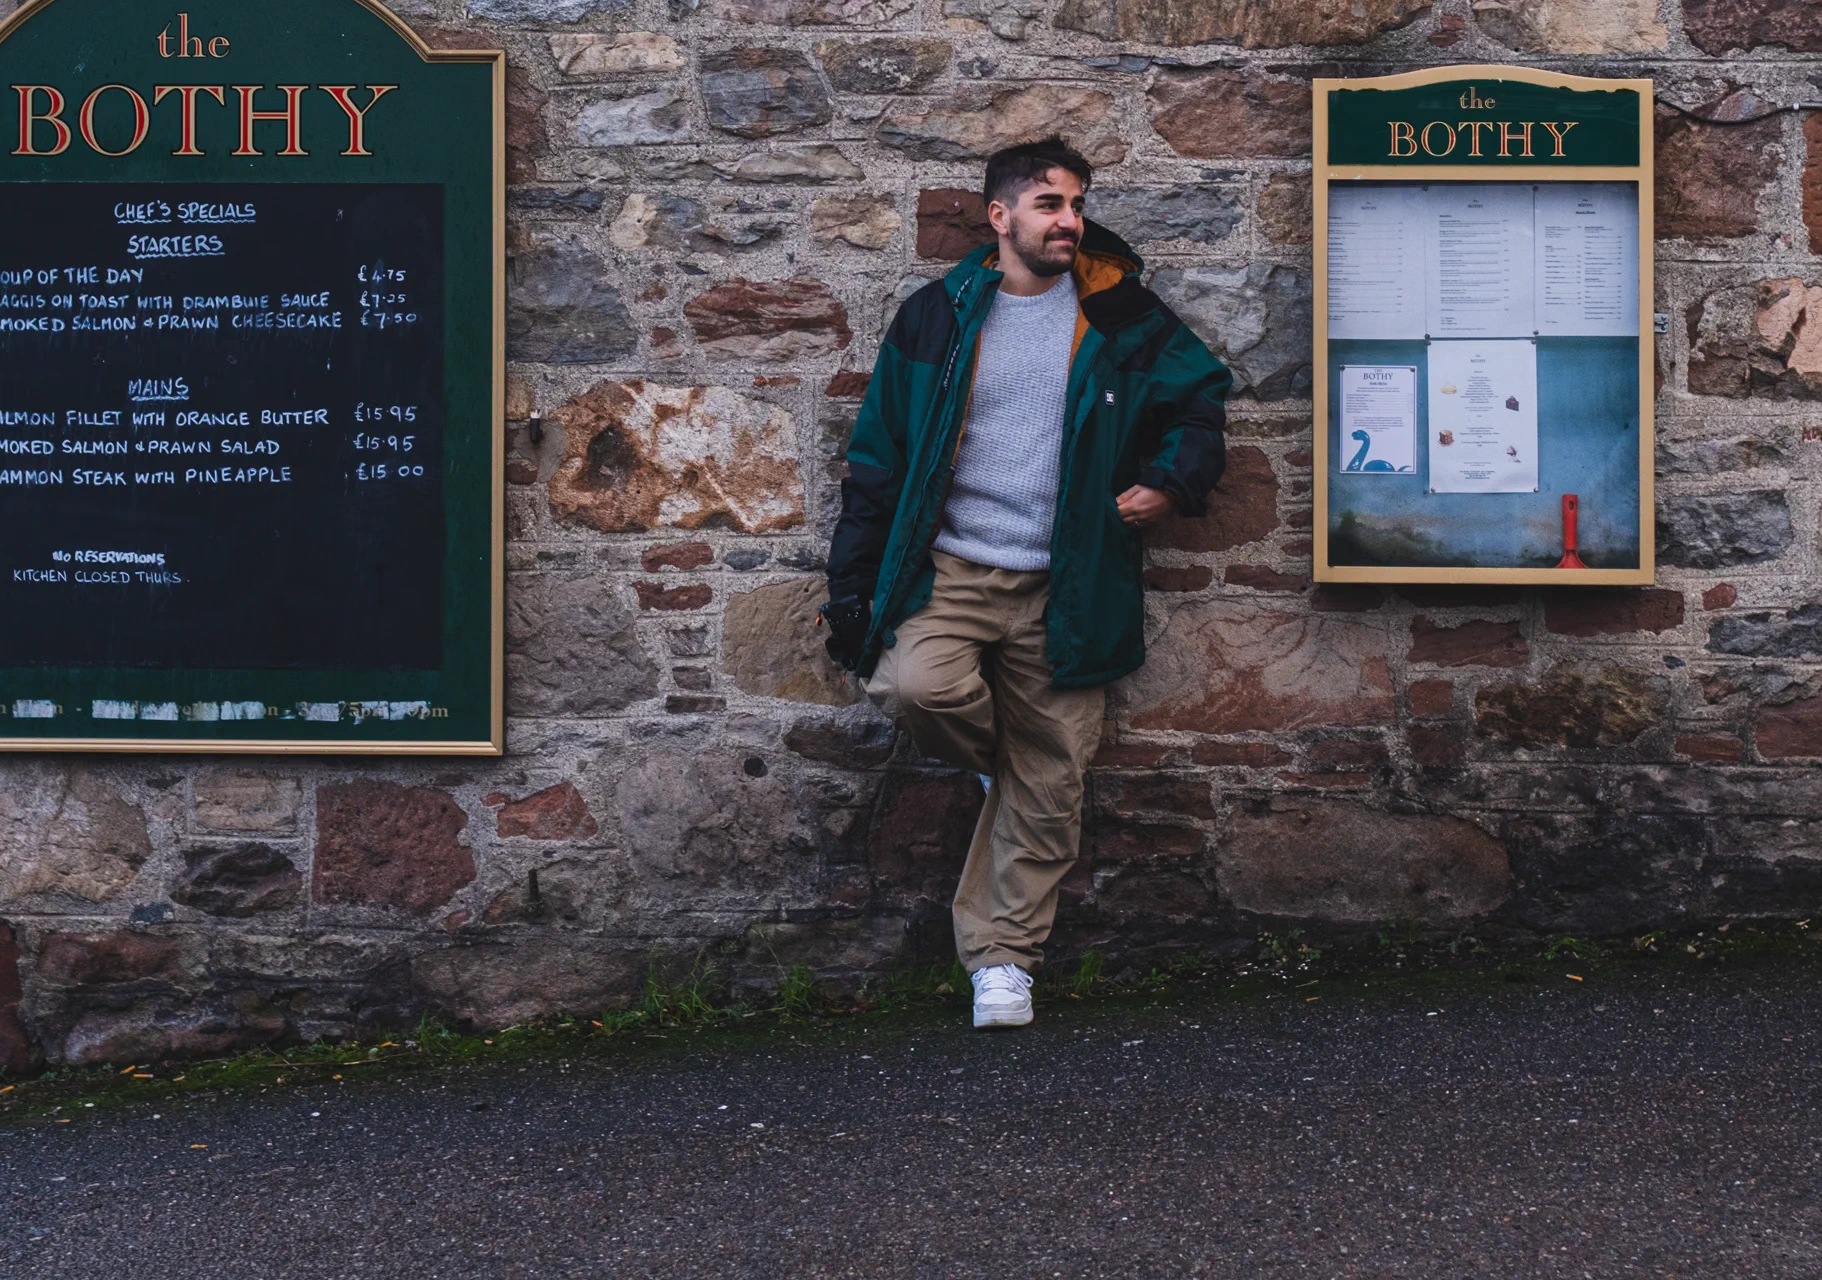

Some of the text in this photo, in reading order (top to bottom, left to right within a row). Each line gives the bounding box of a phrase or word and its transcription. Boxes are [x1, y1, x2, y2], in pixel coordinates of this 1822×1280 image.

[157, 12, 231, 58] the
[1459, 86, 1496, 109] the
[10, 83, 400, 157] BOTHY
[1387, 121, 1579, 157] BOTHY
[114, 200, 257, 221] CHEF'S SPECIALS
[126, 234, 224, 255] STARTERS
[37, 268, 59, 285] OF
[63, 266, 100, 284] THE
[105, 268, 144, 284] DAY
[51, 294, 73, 308] ON
[79, 294, 129, 308] TOAST
[137, 295, 173, 308] WITH
[183, 294, 269, 308] DRAMBUIE
[281, 291, 330, 307] SAUCE
[72, 315, 136, 331] SALMON
[158, 314, 219, 329] PRAWN
[232, 311, 342, 328] CHEESECAKE
[1363, 372, 1394, 381] BOTHY
[128, 377, 189, 396] MAINS
[66, 410, 123, 426] FILLET
[132, 411, 165, 426] WITH
[176, 411, 250, 426] ORANGE
[261, 408, 330, 425] BUTTER
[62, 439, 128, 454] SALMON
[148, 440, 211, 454] PRAWN
[221, 439, 280, 455] SALAD
[72, 468, 127, 486] STEAK
[135, 471, 175, 484] WITH
[186, 466, 292, 484] PINEAPPLE
[75, 550, 166, 566] RESERVATIONS
[13, 569, 67, 582] KITCHEN
[75, 570, 130, 584] CLOSED
